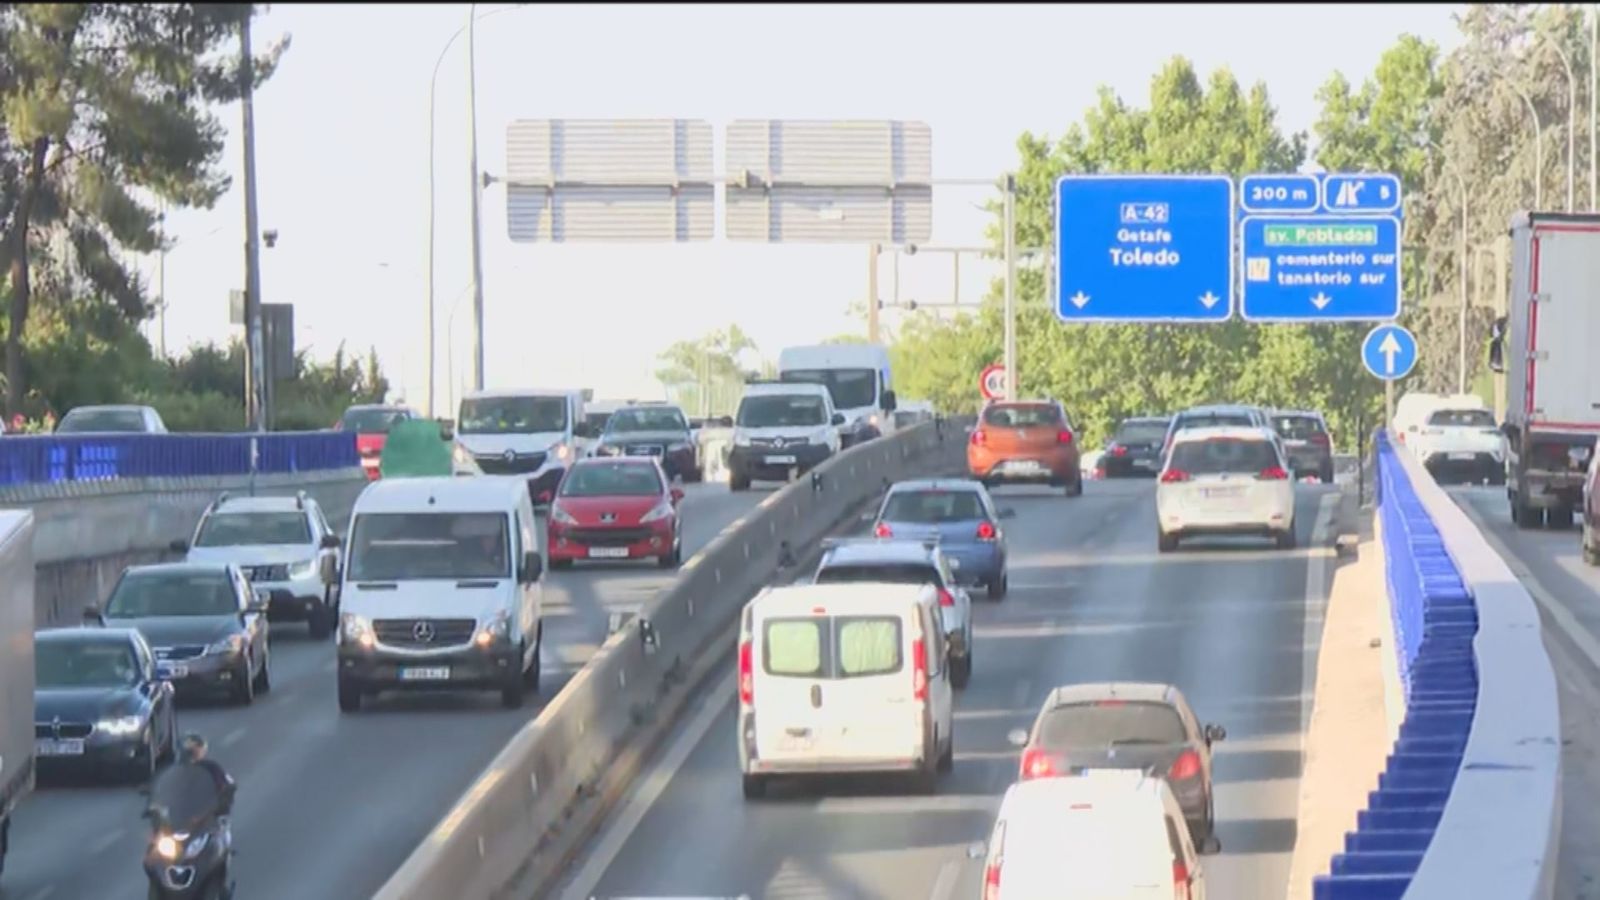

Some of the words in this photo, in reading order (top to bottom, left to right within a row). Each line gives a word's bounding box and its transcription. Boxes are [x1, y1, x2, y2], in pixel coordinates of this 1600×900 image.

[1292, 189, 1308, 201] m
[1124, 204, 1167, 221] A-42
[1117, 228, 1172, 243] Getafe
[1296, 228, 1374, 243] Poblados
[1109, 247, 1181, 266] Toledo
[1277, 252, 1365, 266] cementerio
[1372, 253, 1395, 266] sur
[1277, 271, 1352, 285] tanatorio
[1360, 273, 1386, 285] sur
